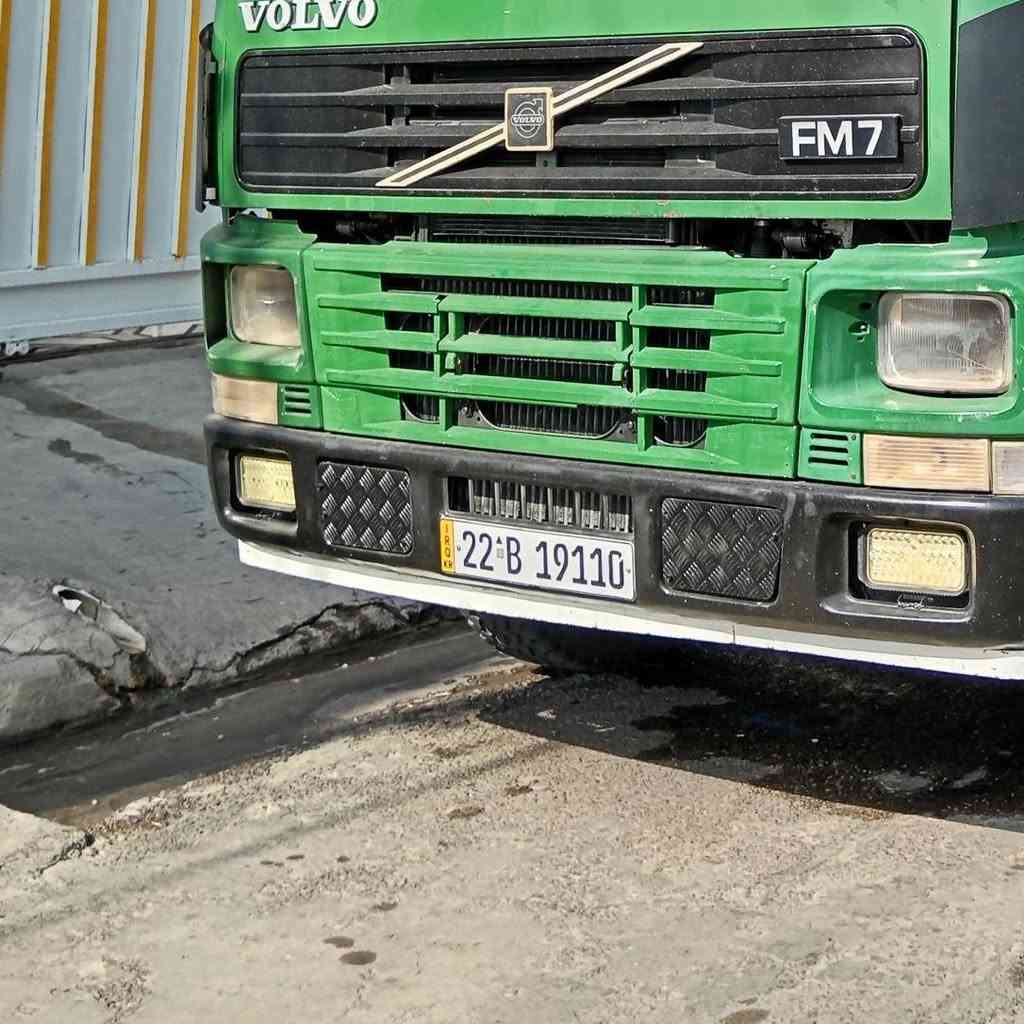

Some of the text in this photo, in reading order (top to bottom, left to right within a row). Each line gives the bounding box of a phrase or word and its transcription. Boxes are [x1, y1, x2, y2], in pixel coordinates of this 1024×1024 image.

[512, 115, 544, 124] VOLVO
[462, 530, 625, 590] 22 B 19110
